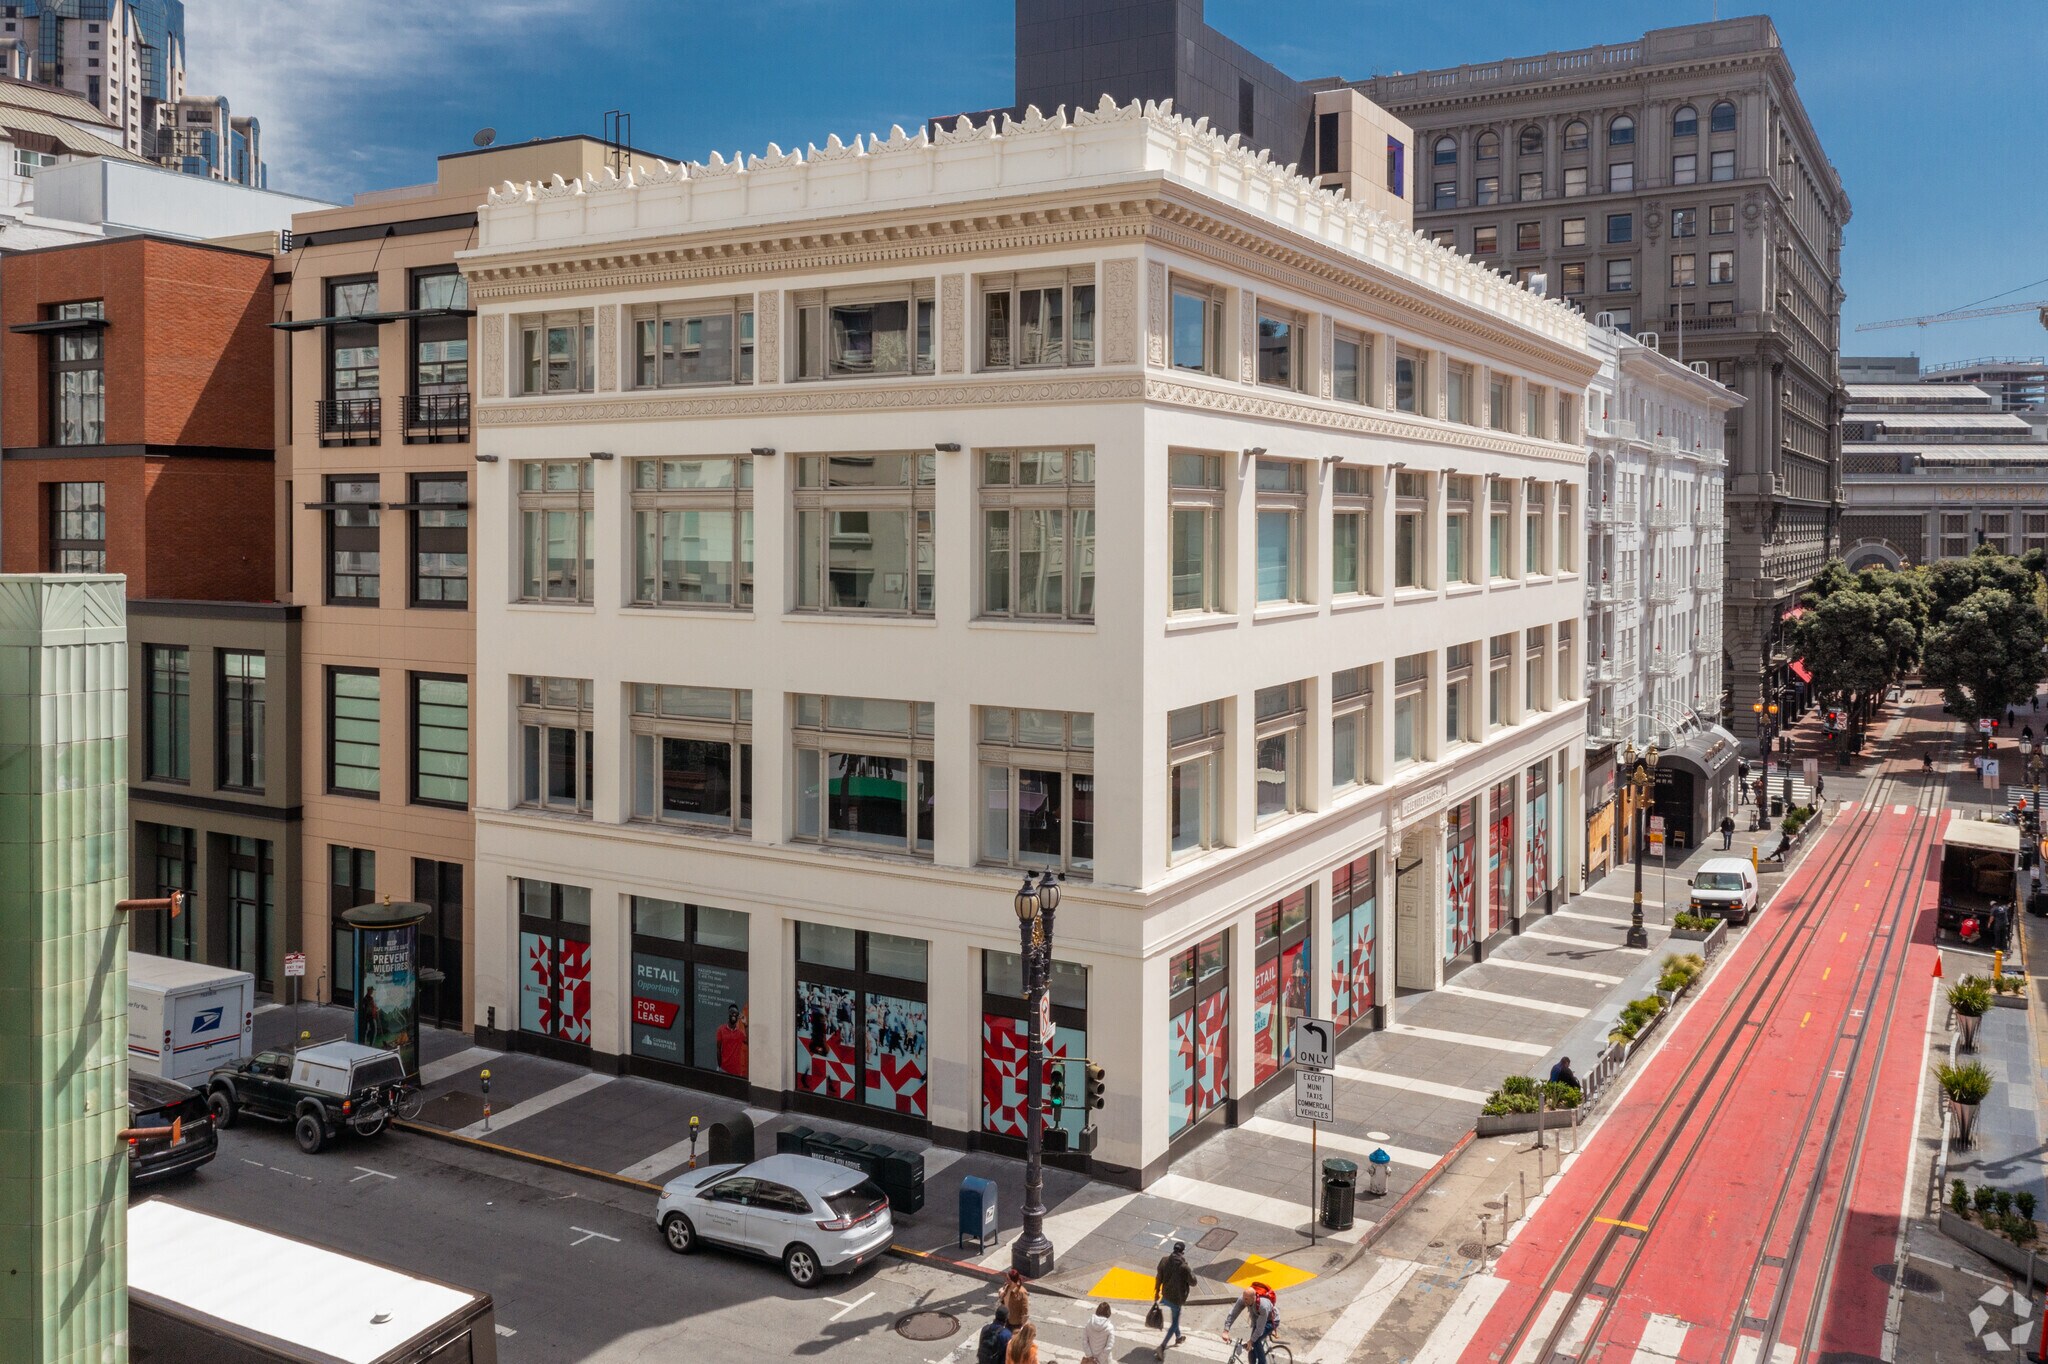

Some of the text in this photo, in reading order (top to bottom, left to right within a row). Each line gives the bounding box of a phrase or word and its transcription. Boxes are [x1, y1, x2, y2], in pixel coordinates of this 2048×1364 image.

[373, 952, 409, 964] PREVENT
[373, 962, 409, 972] WILDFIRES
[637, 964, 680, 982] RETAIL
[637, 980, 680, 996] Opportunity
[638, 1000, 656, 1012] FOR
[638, 1011, 664, 1024] LEASE
[1300, 1051, 1328, 1064] ONLY
[1303, 1074, 1325, 1083] EXCEPT
[1306, 1092, 1323, 1100] TAXIS
[1298, 1099, 1331, 1111] COMMERCIAL
[1301, 1109, 1329, 1119] VEHICLES
